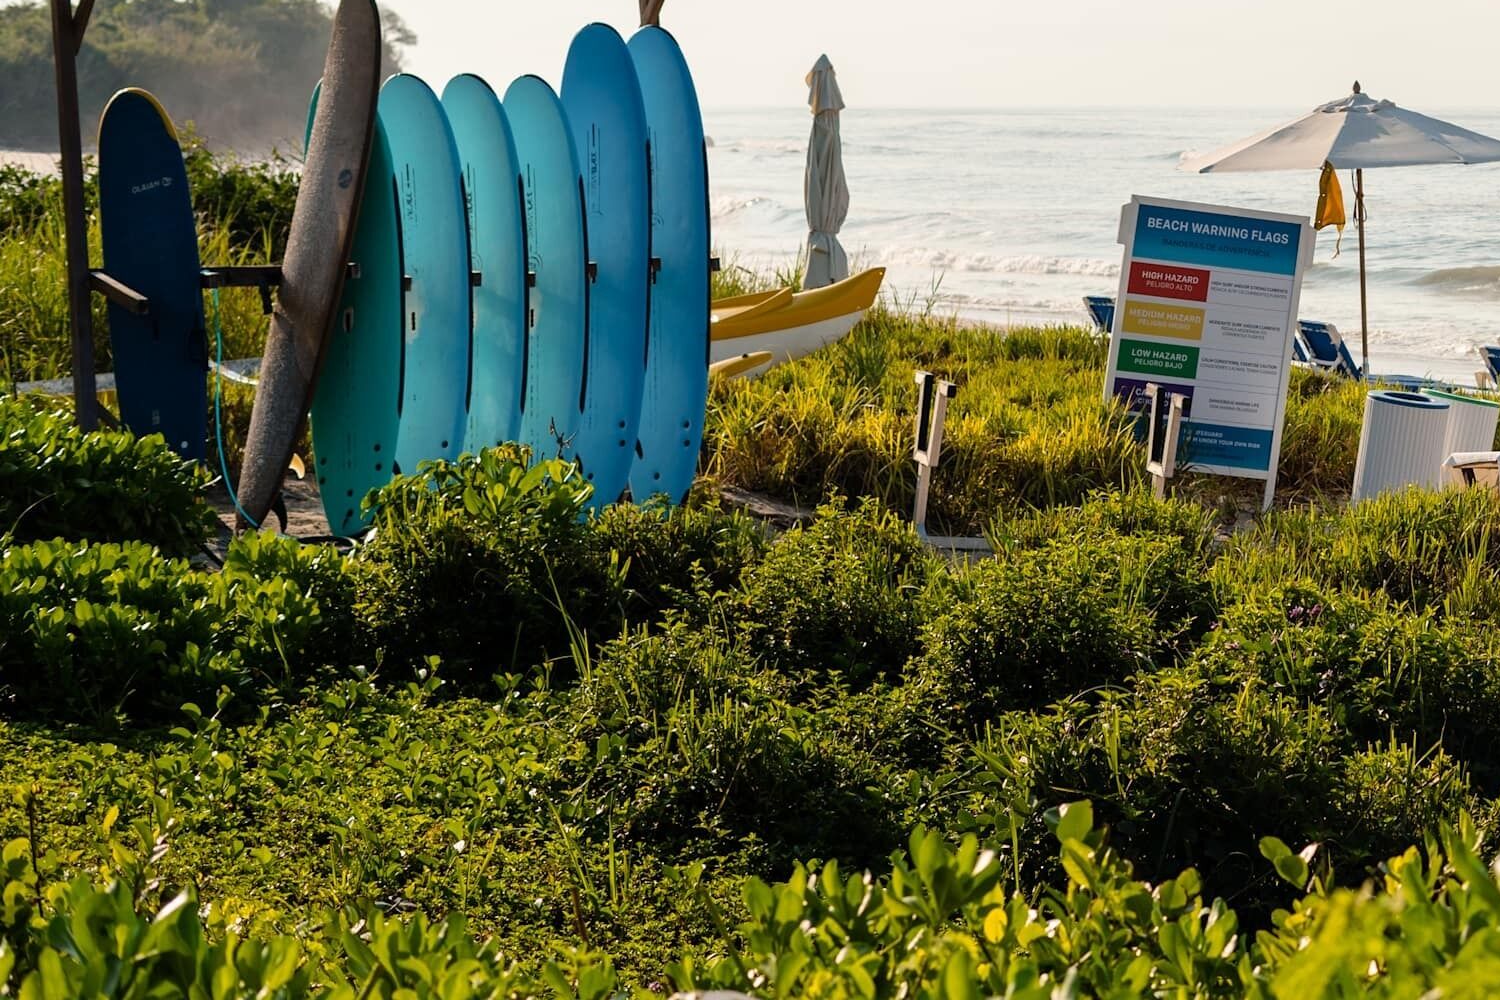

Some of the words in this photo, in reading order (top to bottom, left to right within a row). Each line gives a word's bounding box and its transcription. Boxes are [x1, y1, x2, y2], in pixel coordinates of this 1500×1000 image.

[1147, 217, 1188, 231] BEACH
[1191, 222, 1248, 239] WARNING
[1251, 229, 1289, 244] FLAGS
[1142, 270, 1162, 280] HIGH
[1164, 273, 1198, 284] HAZARD
[1146, 280, 1174, 290] PELIGRO
[1175, 283, 1192, 291] ALTO
[1129, 307, 1165, 319] MEDIUM
[1166, 311, 1201, 323] HAZARD
[1131, 348, 1151, 358] LOW
[1153, 350, 1187, 361] HAZARD
[1134, 357, 1164, 367] PELIGRO
[1164, 361, 1182, 369] BAJO
[1194, 429, 1223, 438] IFEGUARD
